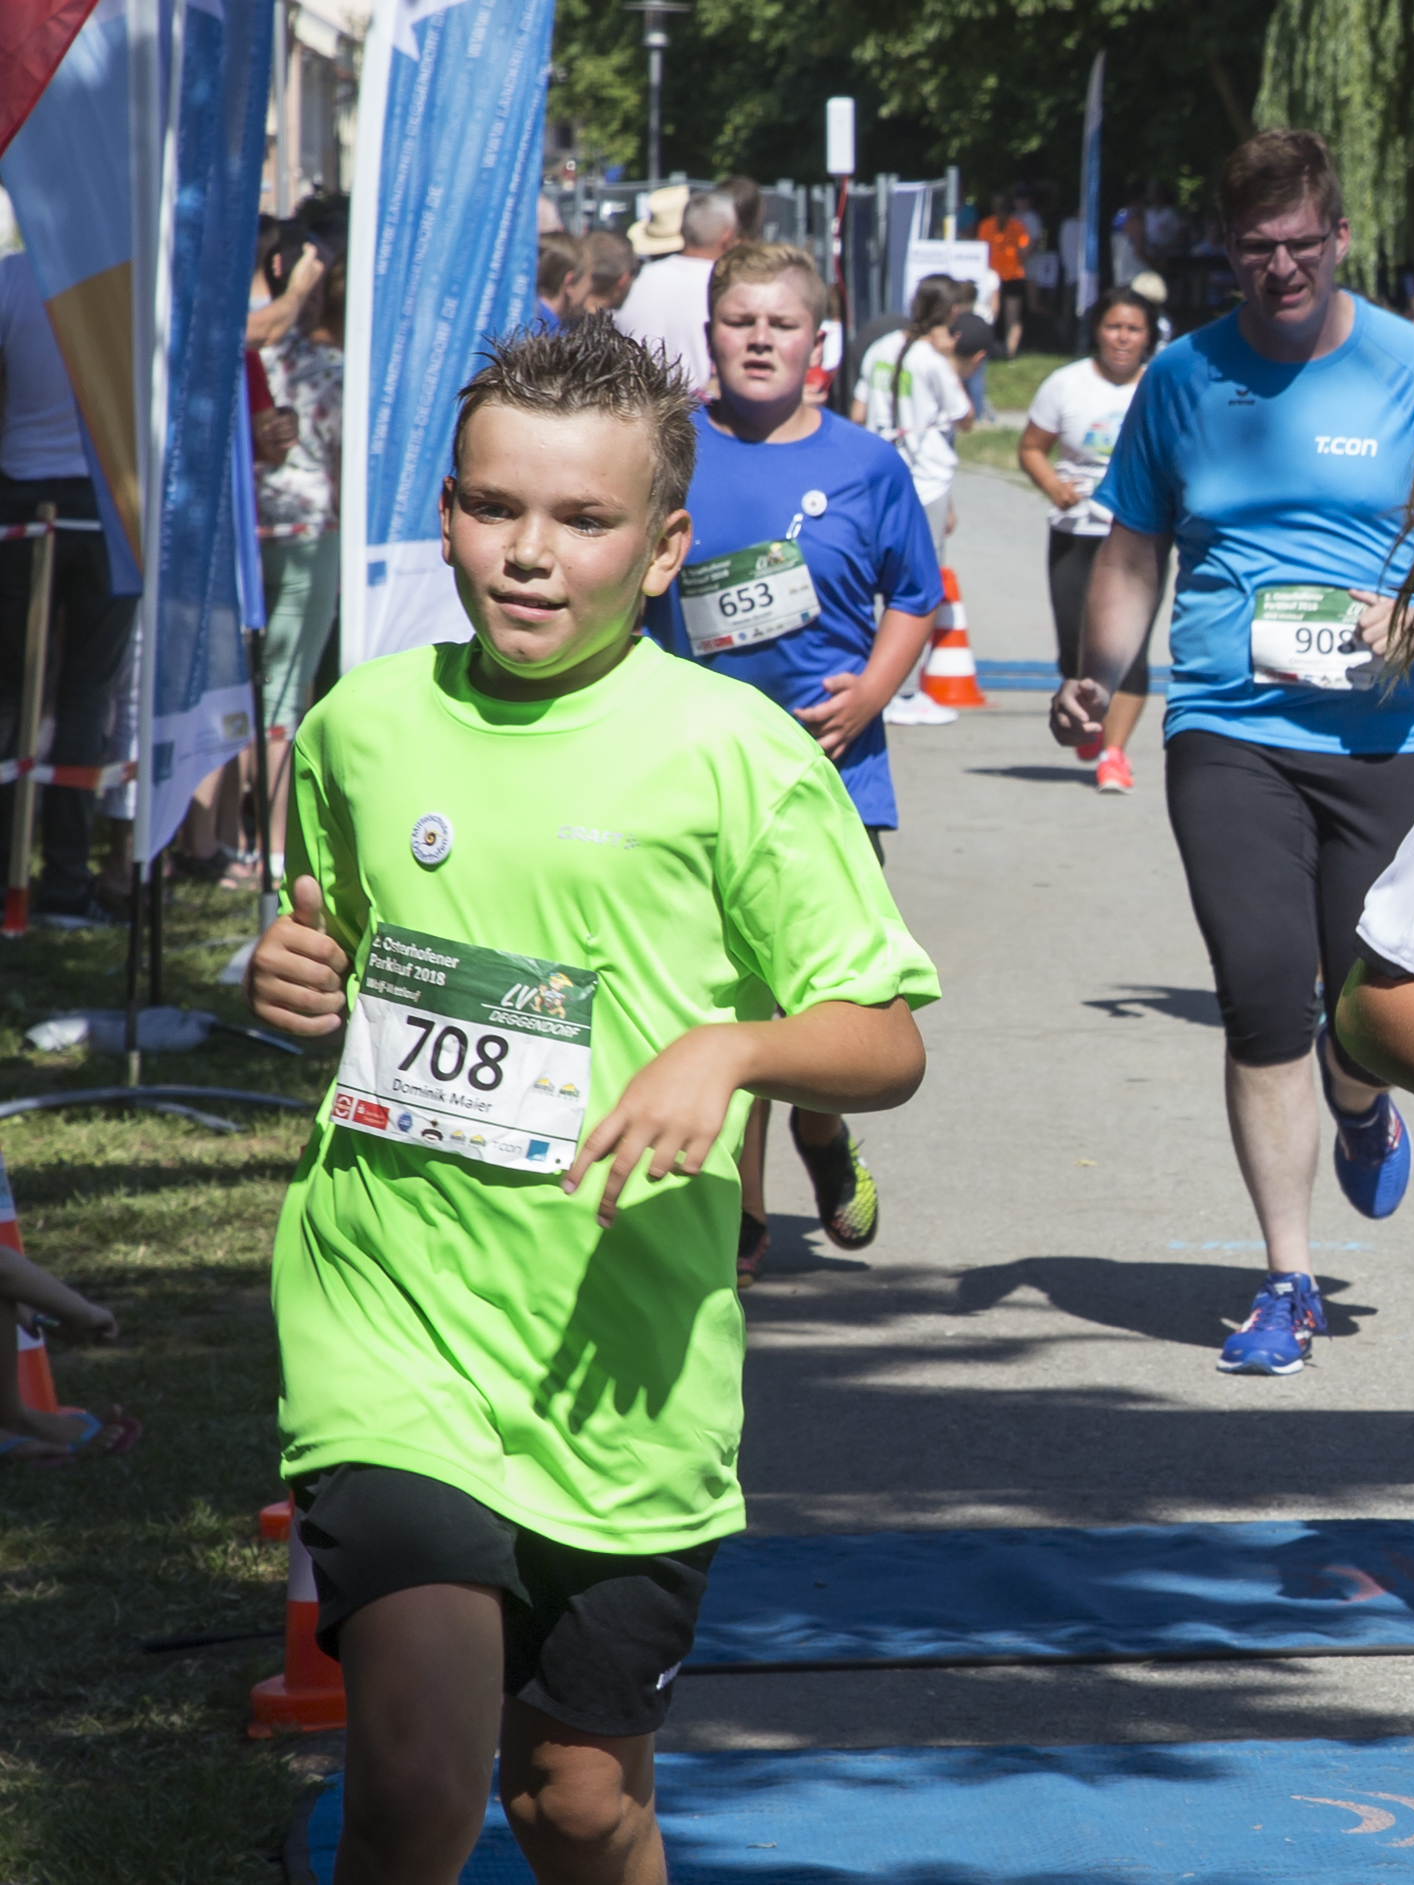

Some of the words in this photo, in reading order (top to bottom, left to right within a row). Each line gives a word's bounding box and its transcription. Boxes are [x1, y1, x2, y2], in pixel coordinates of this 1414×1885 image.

[718, 582, 774, 617] 653
[1295, 627, 1356, 655] 908
[369, 952, 414, 978] Parklauf
[413, 965, 447, 987] 2018
[382, 936, 460, 969] Osterhofener
[500, 982, 538, 1010] LV
[488, 1009, 582, 1039] DEGGENDORF
[397, 1015, 509, 1092] 708
[392, 1077, 448, 1104] Dominik
[449, 1092, 493, 1114] Maier
